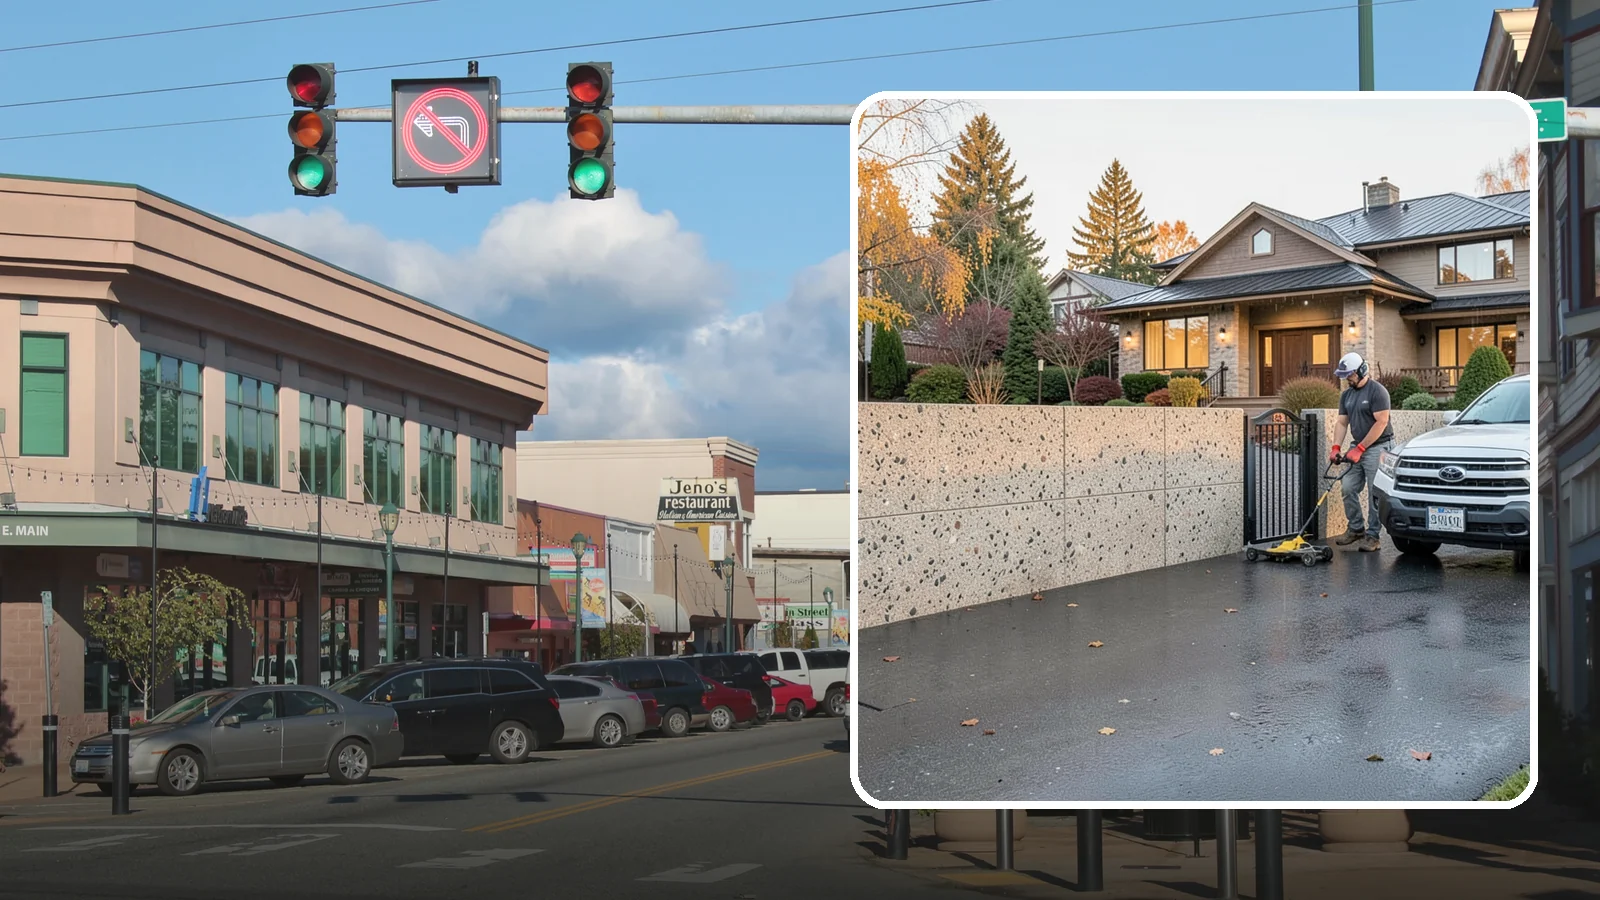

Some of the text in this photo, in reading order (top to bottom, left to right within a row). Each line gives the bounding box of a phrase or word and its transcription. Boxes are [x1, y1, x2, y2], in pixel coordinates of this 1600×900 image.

[670, 480, 727, 494] Jeno's
[665, 496, 731, 509] restaurant
[686, 510, 714, 520] American
[715, 509, 738, 519] Cuisine
[2, 525, 49, 536] E. MAIN
[798, 607, 828, 616] Street
